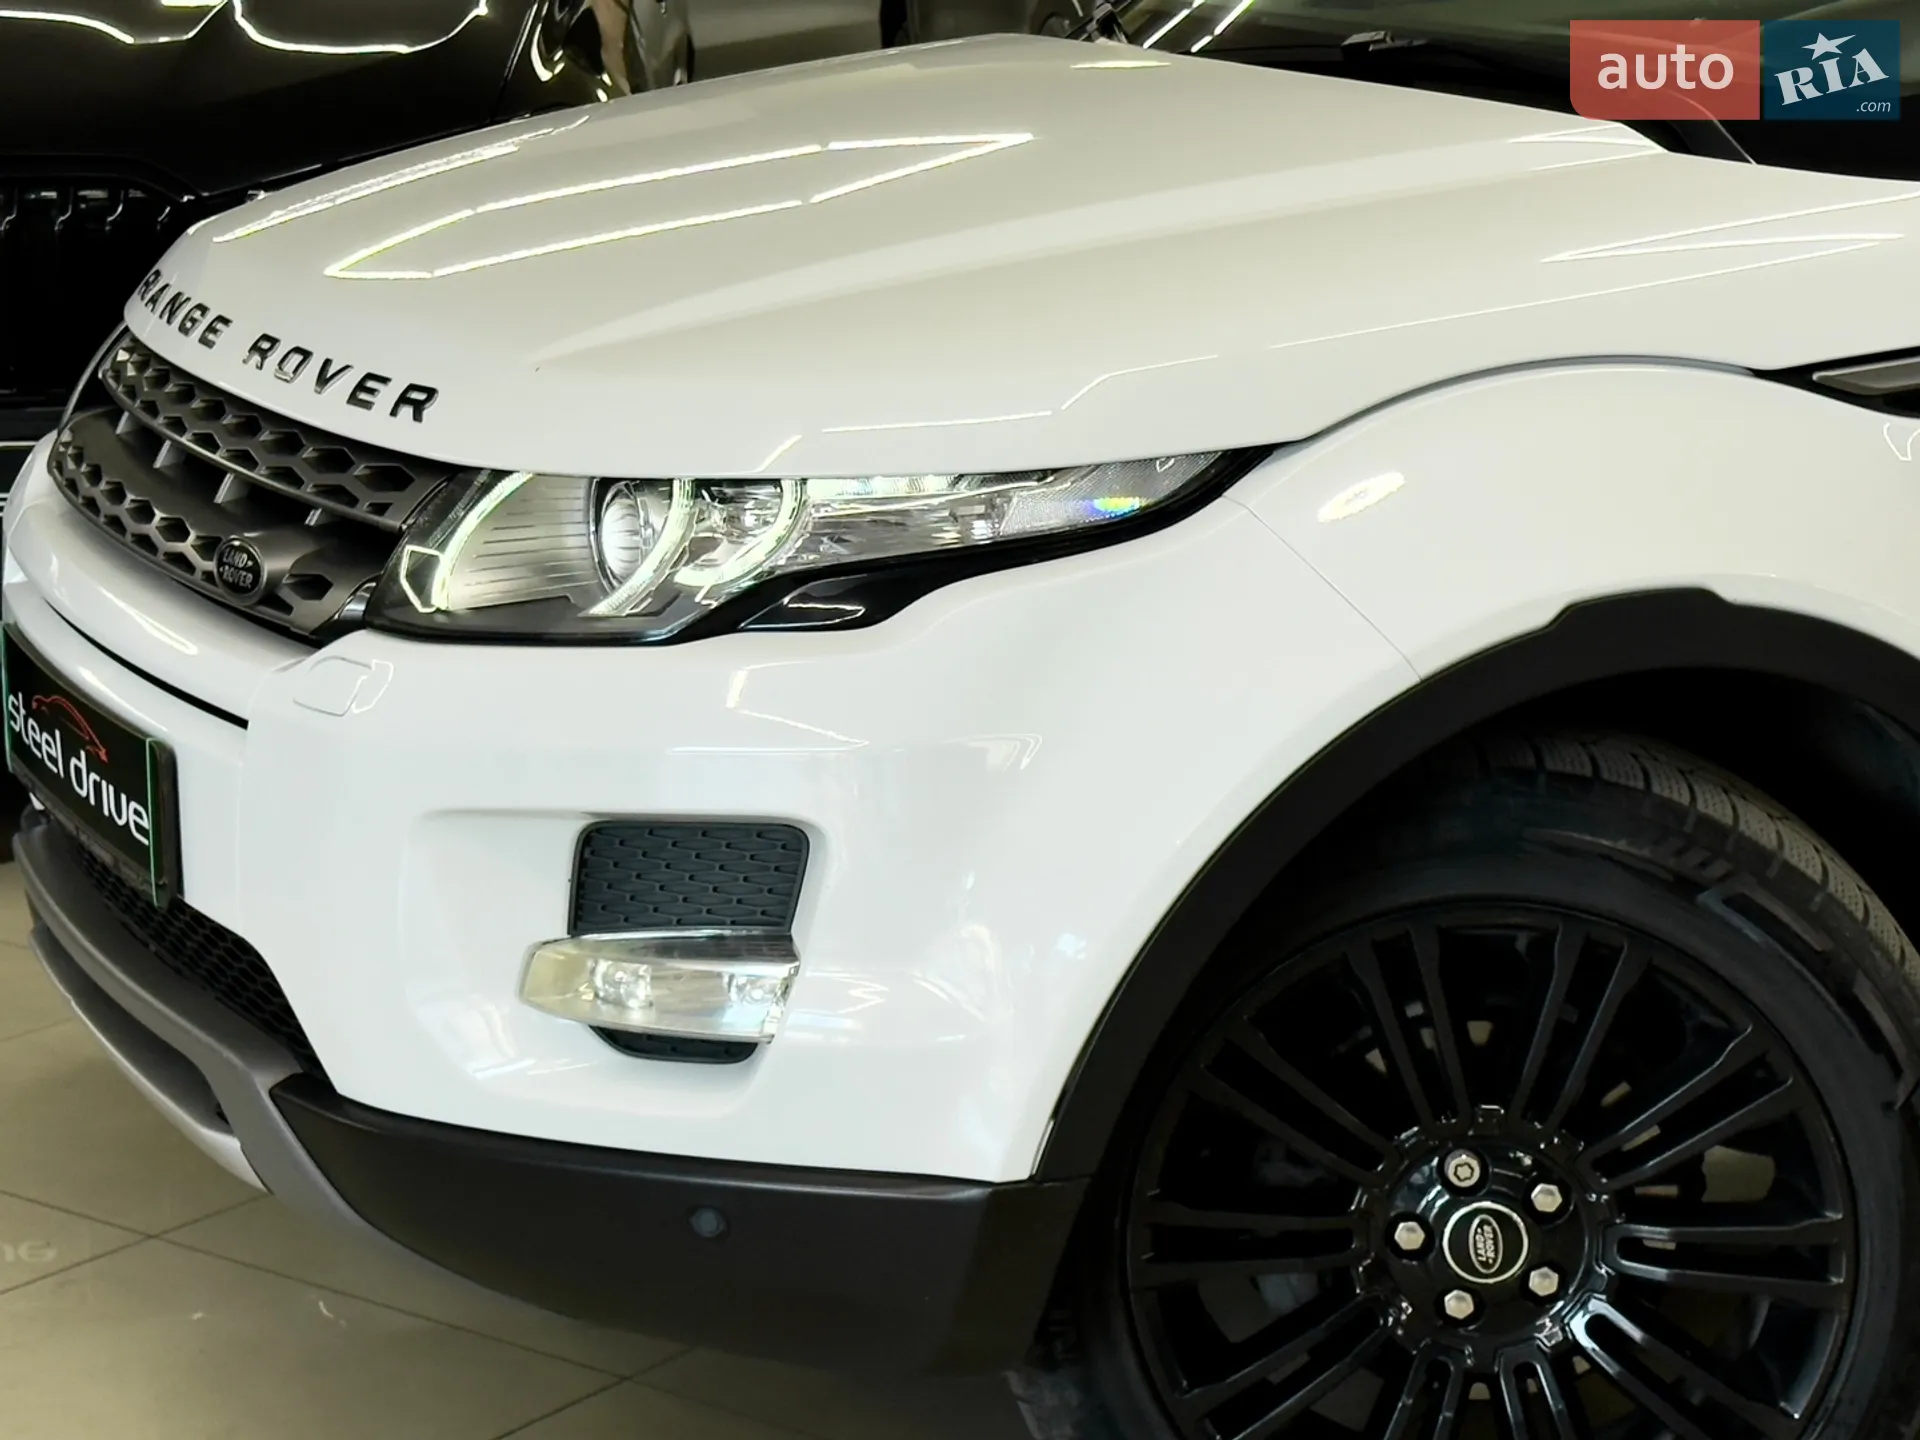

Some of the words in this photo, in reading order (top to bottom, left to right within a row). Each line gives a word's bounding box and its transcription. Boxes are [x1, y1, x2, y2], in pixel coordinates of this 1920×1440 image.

[137, 268, 233, 349] RANGE
[242, 333, 440, 424] ROVER
[8, 691, 64, 779] steel
[69, 748, 150, 847] drive
